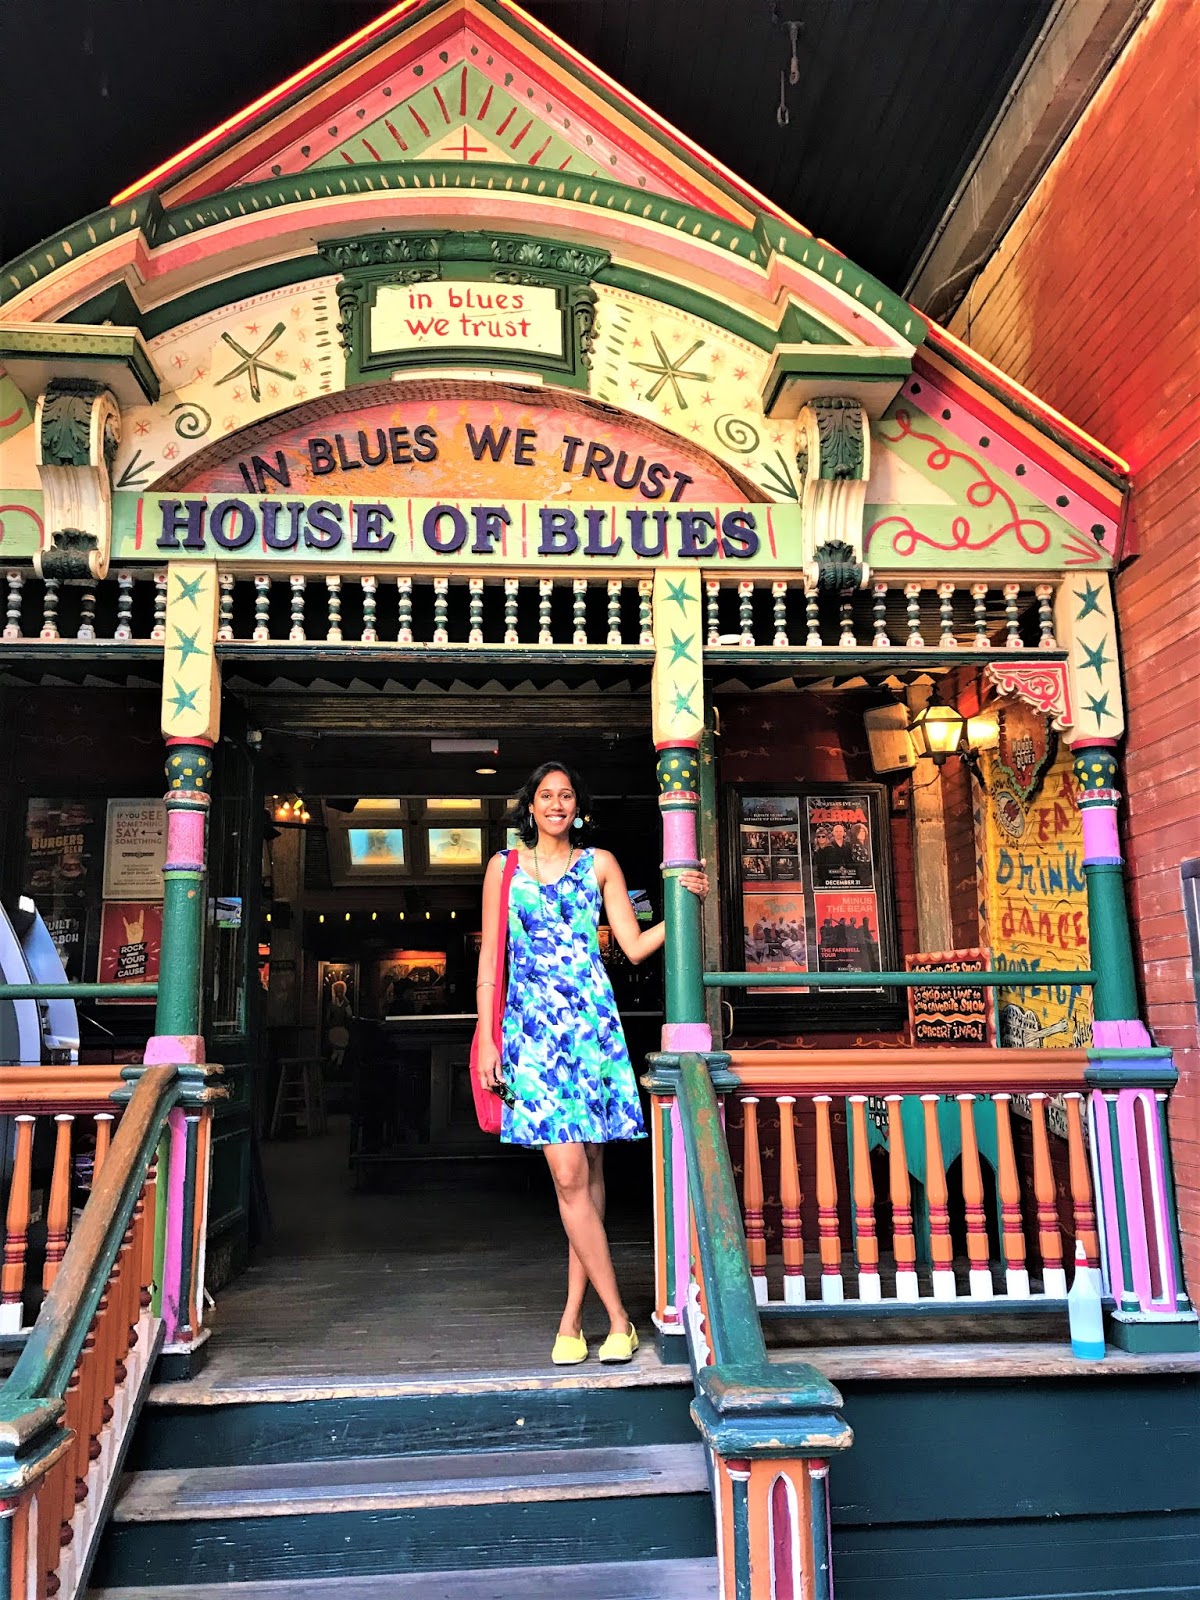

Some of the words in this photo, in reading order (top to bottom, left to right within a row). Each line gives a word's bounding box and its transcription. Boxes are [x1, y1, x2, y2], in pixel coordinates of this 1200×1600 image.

[409, 289, 432, 310] in
[448, 287, 525, 310] blues
[404, 316, 450, 337] we
[459, 313, 532, 338] trust
[238, 450, 292, 494] IN
[308, 424, 438, 476] BLUES
[465, 422, 537, 467] WE
[562, 434, 693, 502] TRUST
[156, 498, 396, 553] HOUSE
[421, 503, 511, 555] OF
[538, 507, 760, 559] BLUES
[141, 810, 163, 821] SEE
[810, 807, 868, 824] ZEBRA
[116, 820, 163, 828] SOMETHING
[116, 828, 139, 838] SAY
[31, 833, 84, 851] BURGERS
[842, 897, 873, 905] MINUS
[826, 905, 846, 913] THE
[847, 905, 873, 913] BEAR
[121, 943, 145, 954] ROCK
[121, 954, 146, 966] YOUR
[117, 966, 145, 978] CAUSE
[960, 998, 985, 1013] SHOW
[917, 1024, 952, 1039] CONCERT
